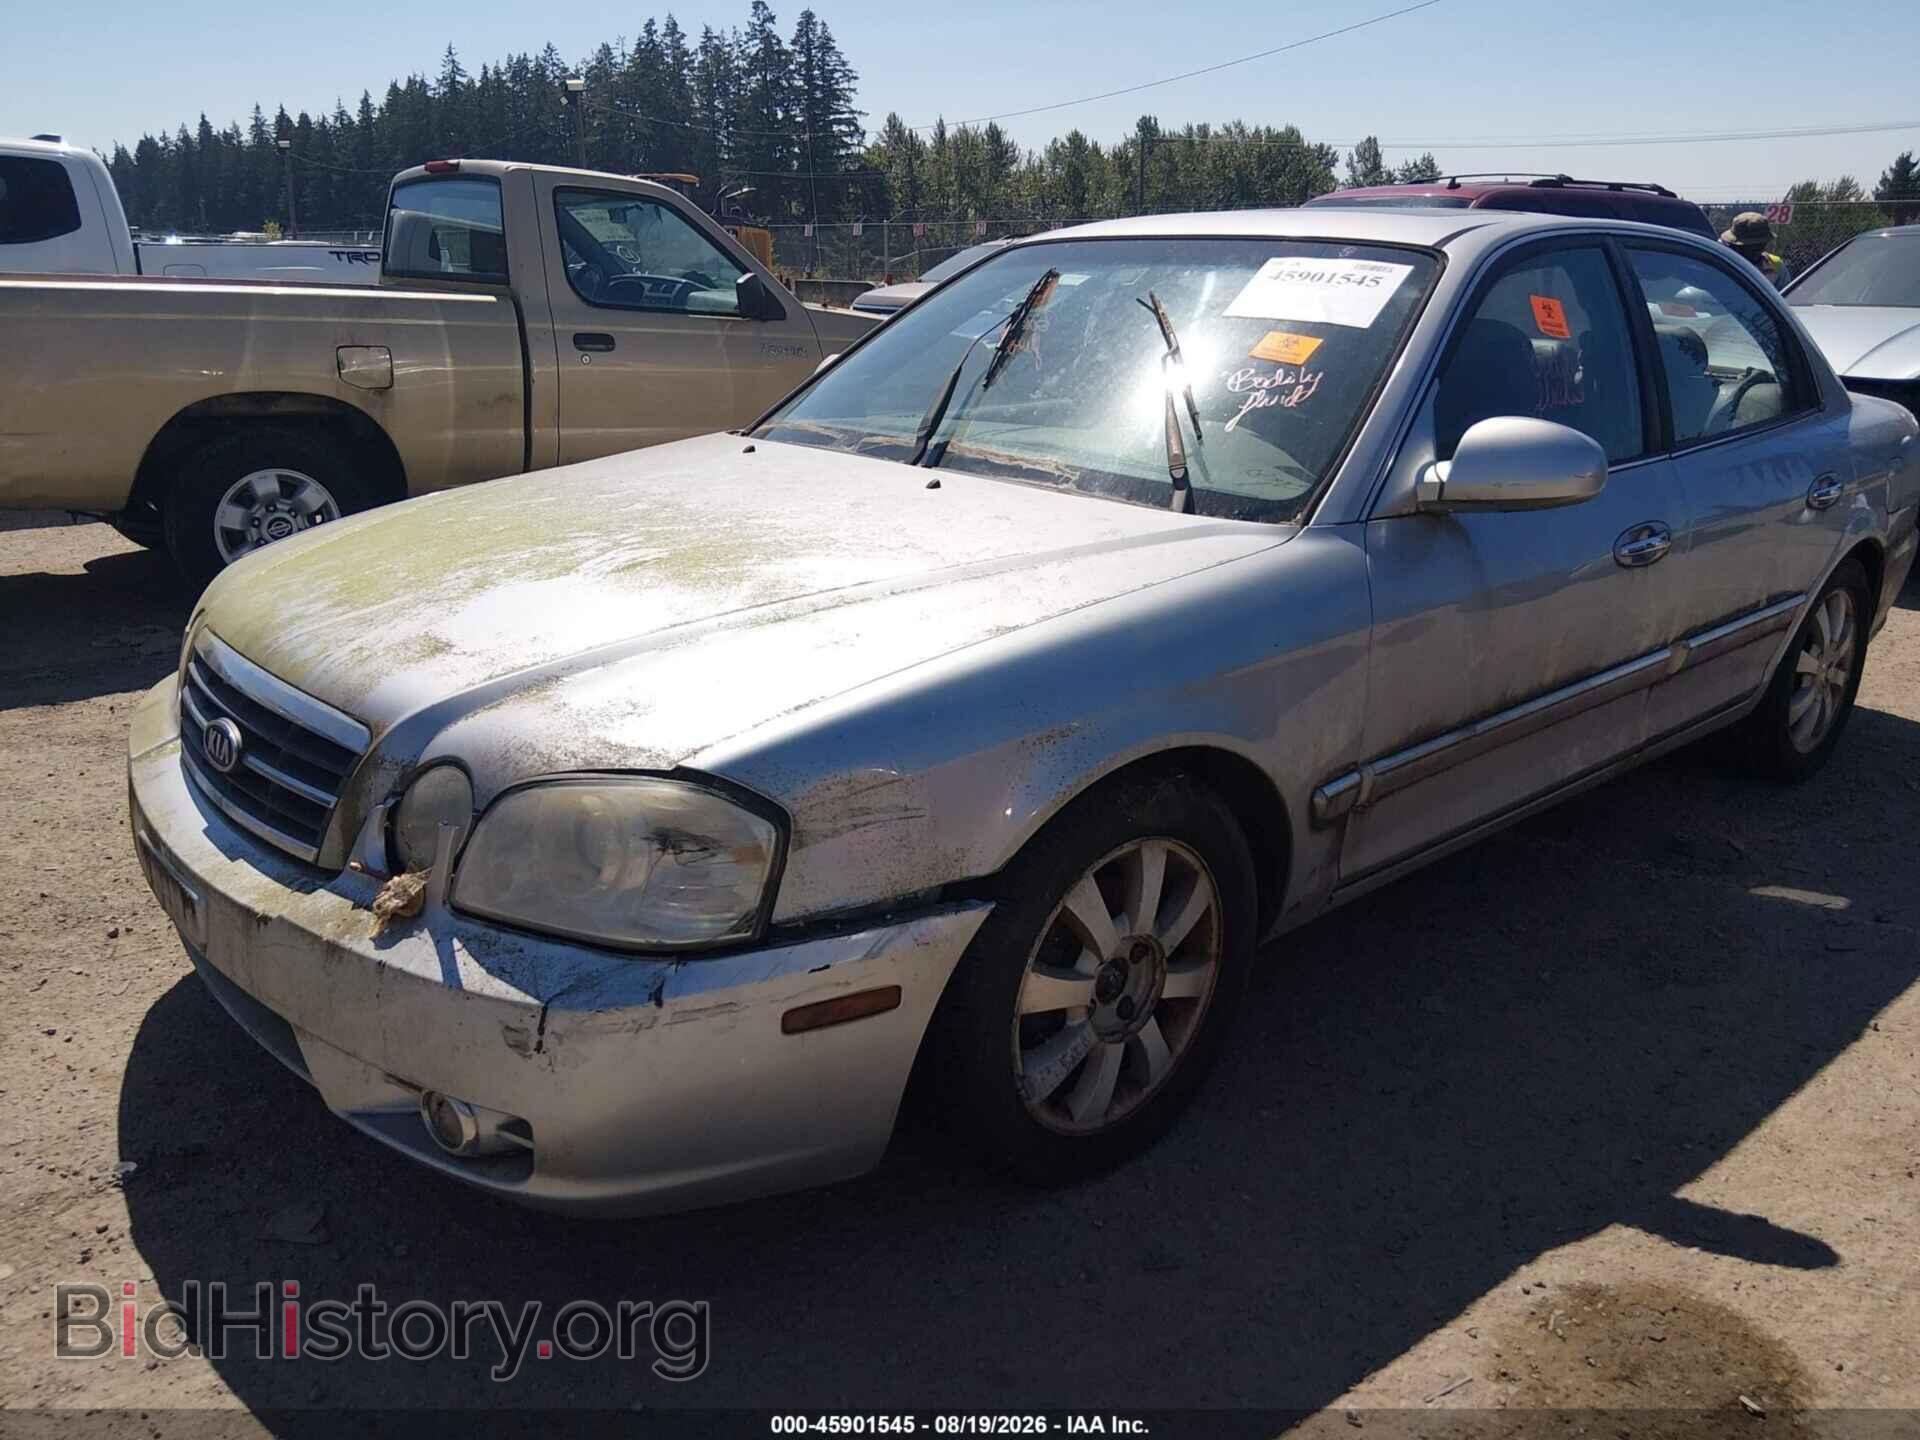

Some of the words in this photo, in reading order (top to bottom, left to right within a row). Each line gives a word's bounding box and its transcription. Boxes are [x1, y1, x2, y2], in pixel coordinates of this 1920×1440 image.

[1768, 205, 1790, 223] 28
[328, 251, 381, 265] TRD
[1269, 269, 1383, 288] 45901545
[1227, 366, 1324, 400] Bodily
[208, 728, 228, 764] KIA
